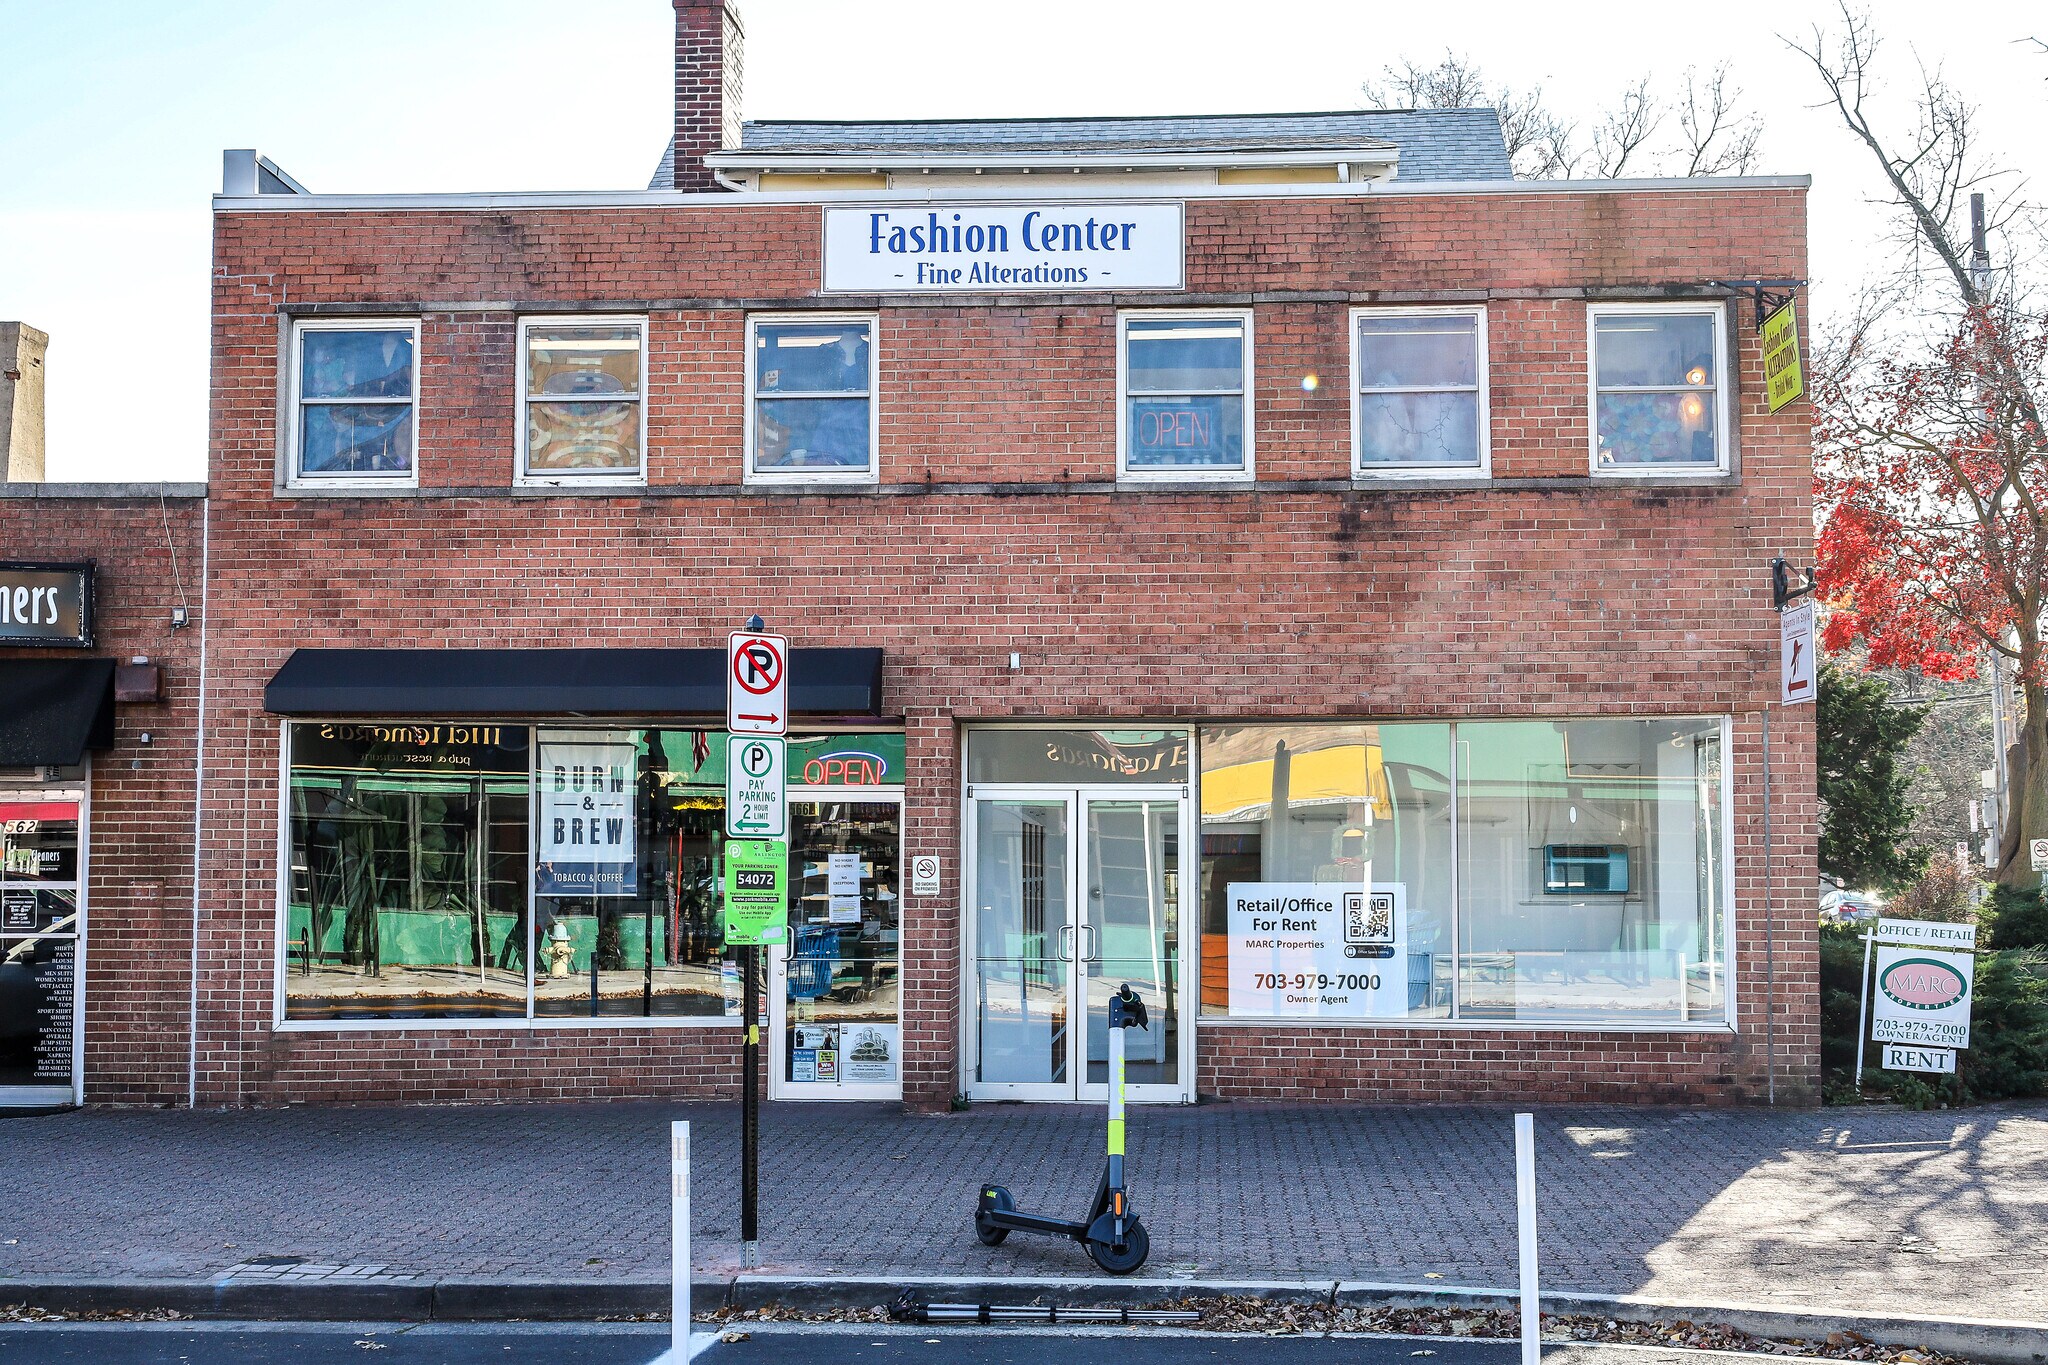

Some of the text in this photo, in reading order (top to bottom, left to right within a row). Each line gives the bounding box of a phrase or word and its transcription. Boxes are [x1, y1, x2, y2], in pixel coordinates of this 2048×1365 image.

[869, 211, 1137, 254] Fashion Center
[916, 261, 1088, 284] Fine Alterations
[1768, 342, 1797, 380] ALTERATIONS
[1140, 412, 1209, 446] OPEN
[0, 585, 58, 624] ners
[752, 748, 764, 771] P
[554, 765, 624, 793] BURN
[804, 759, 881, 785] OPEN
[748, 780, 765, 790] PAY
[582, 796, 595, 811] &
[739, 791, 776, 802] PARKING
[743, 803, 769, 819] 2 HOUR
[753, 812, 769, 820] LIMIT
[5, 821, 36, 832] 562
[553, 818, 624, 845] BREW
[553, 873, 623, 882] TOBACCO & COFFEE
[737, 873, 774, 885] 54072
[1236, 897, 1333, 915] Retail/Office
[1253, 918, 1317, 932] For Rent
[1879, 925, 1921, 936] OFFICE
[1931, 928, 1974, 941] RETAIL
[1245, 940, 1325, 951] MARC Properties
[1254, 974, 1381, 990] 703-979-7000
[1891, 973, 1957, 995] MARC
[1286, 994, 1348, 1005] Owner Agent
[1884, 988, 1963, 1010] PROPERTIES
[1876, 1018, 1967, 1036] 703-979-7000
[1876, 1029, 1964, 1044] OWNER/AGENT
[1889, 1050, 1949, 1069] RENT
